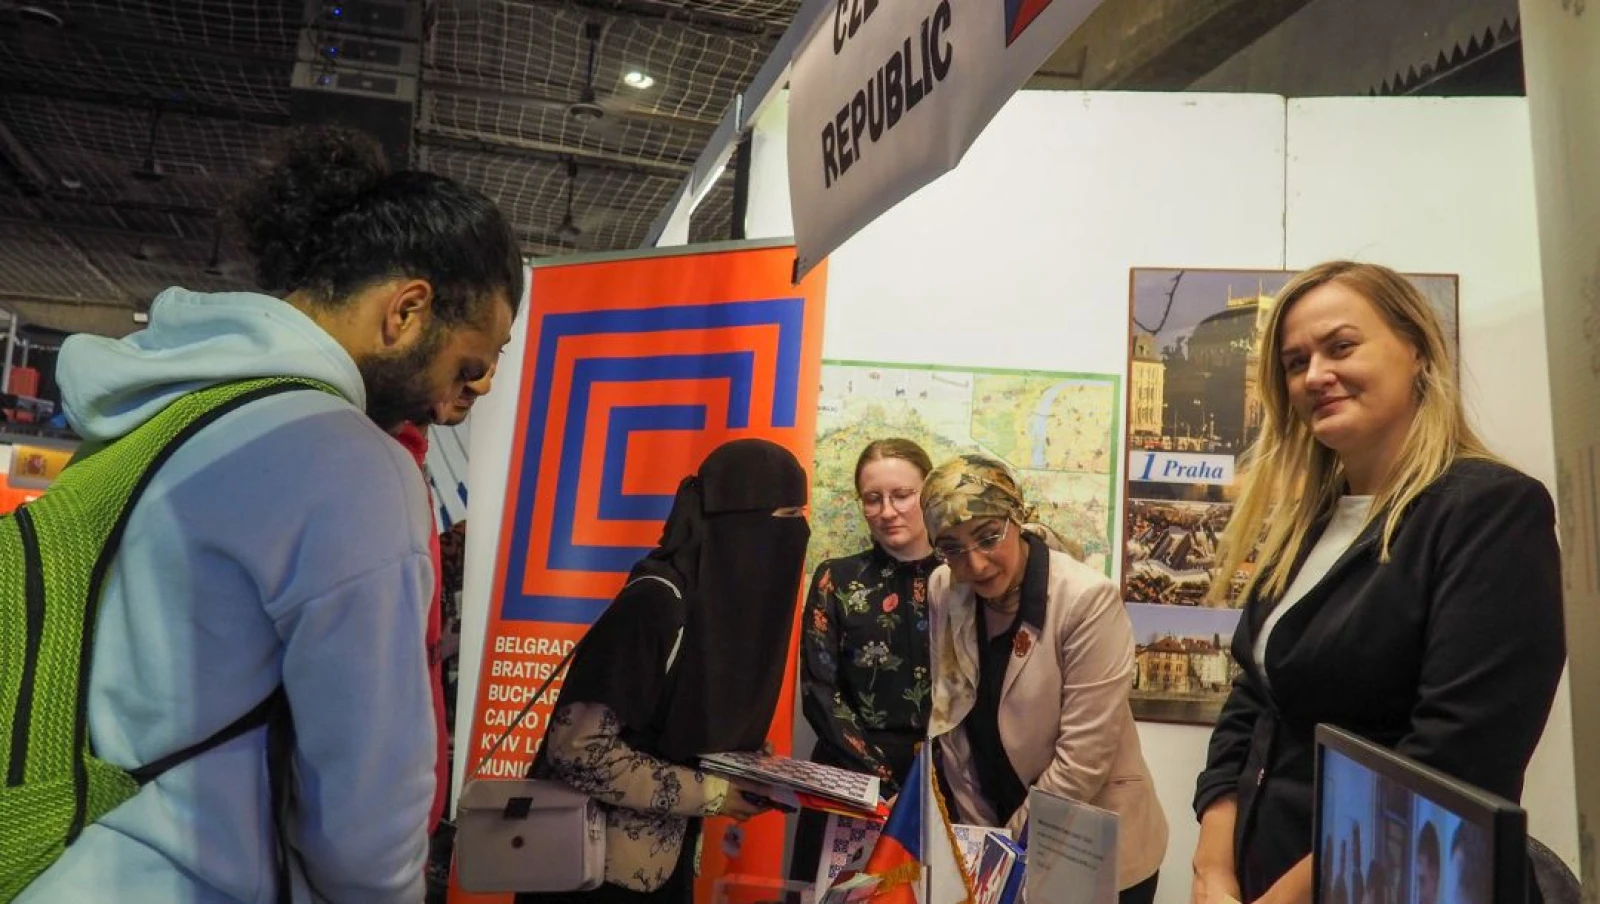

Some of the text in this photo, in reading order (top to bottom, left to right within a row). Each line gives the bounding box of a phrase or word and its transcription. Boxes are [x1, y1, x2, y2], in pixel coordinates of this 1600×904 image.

[821, 0, 953, 188] REPUBLIC
[1139, 453, 1223, 481] 1 Praha
[495, 636, 575, 656] BELGRAD
[485, 708, 539, 730] CAIRO
[481, 733, 521, 751] KYIV
